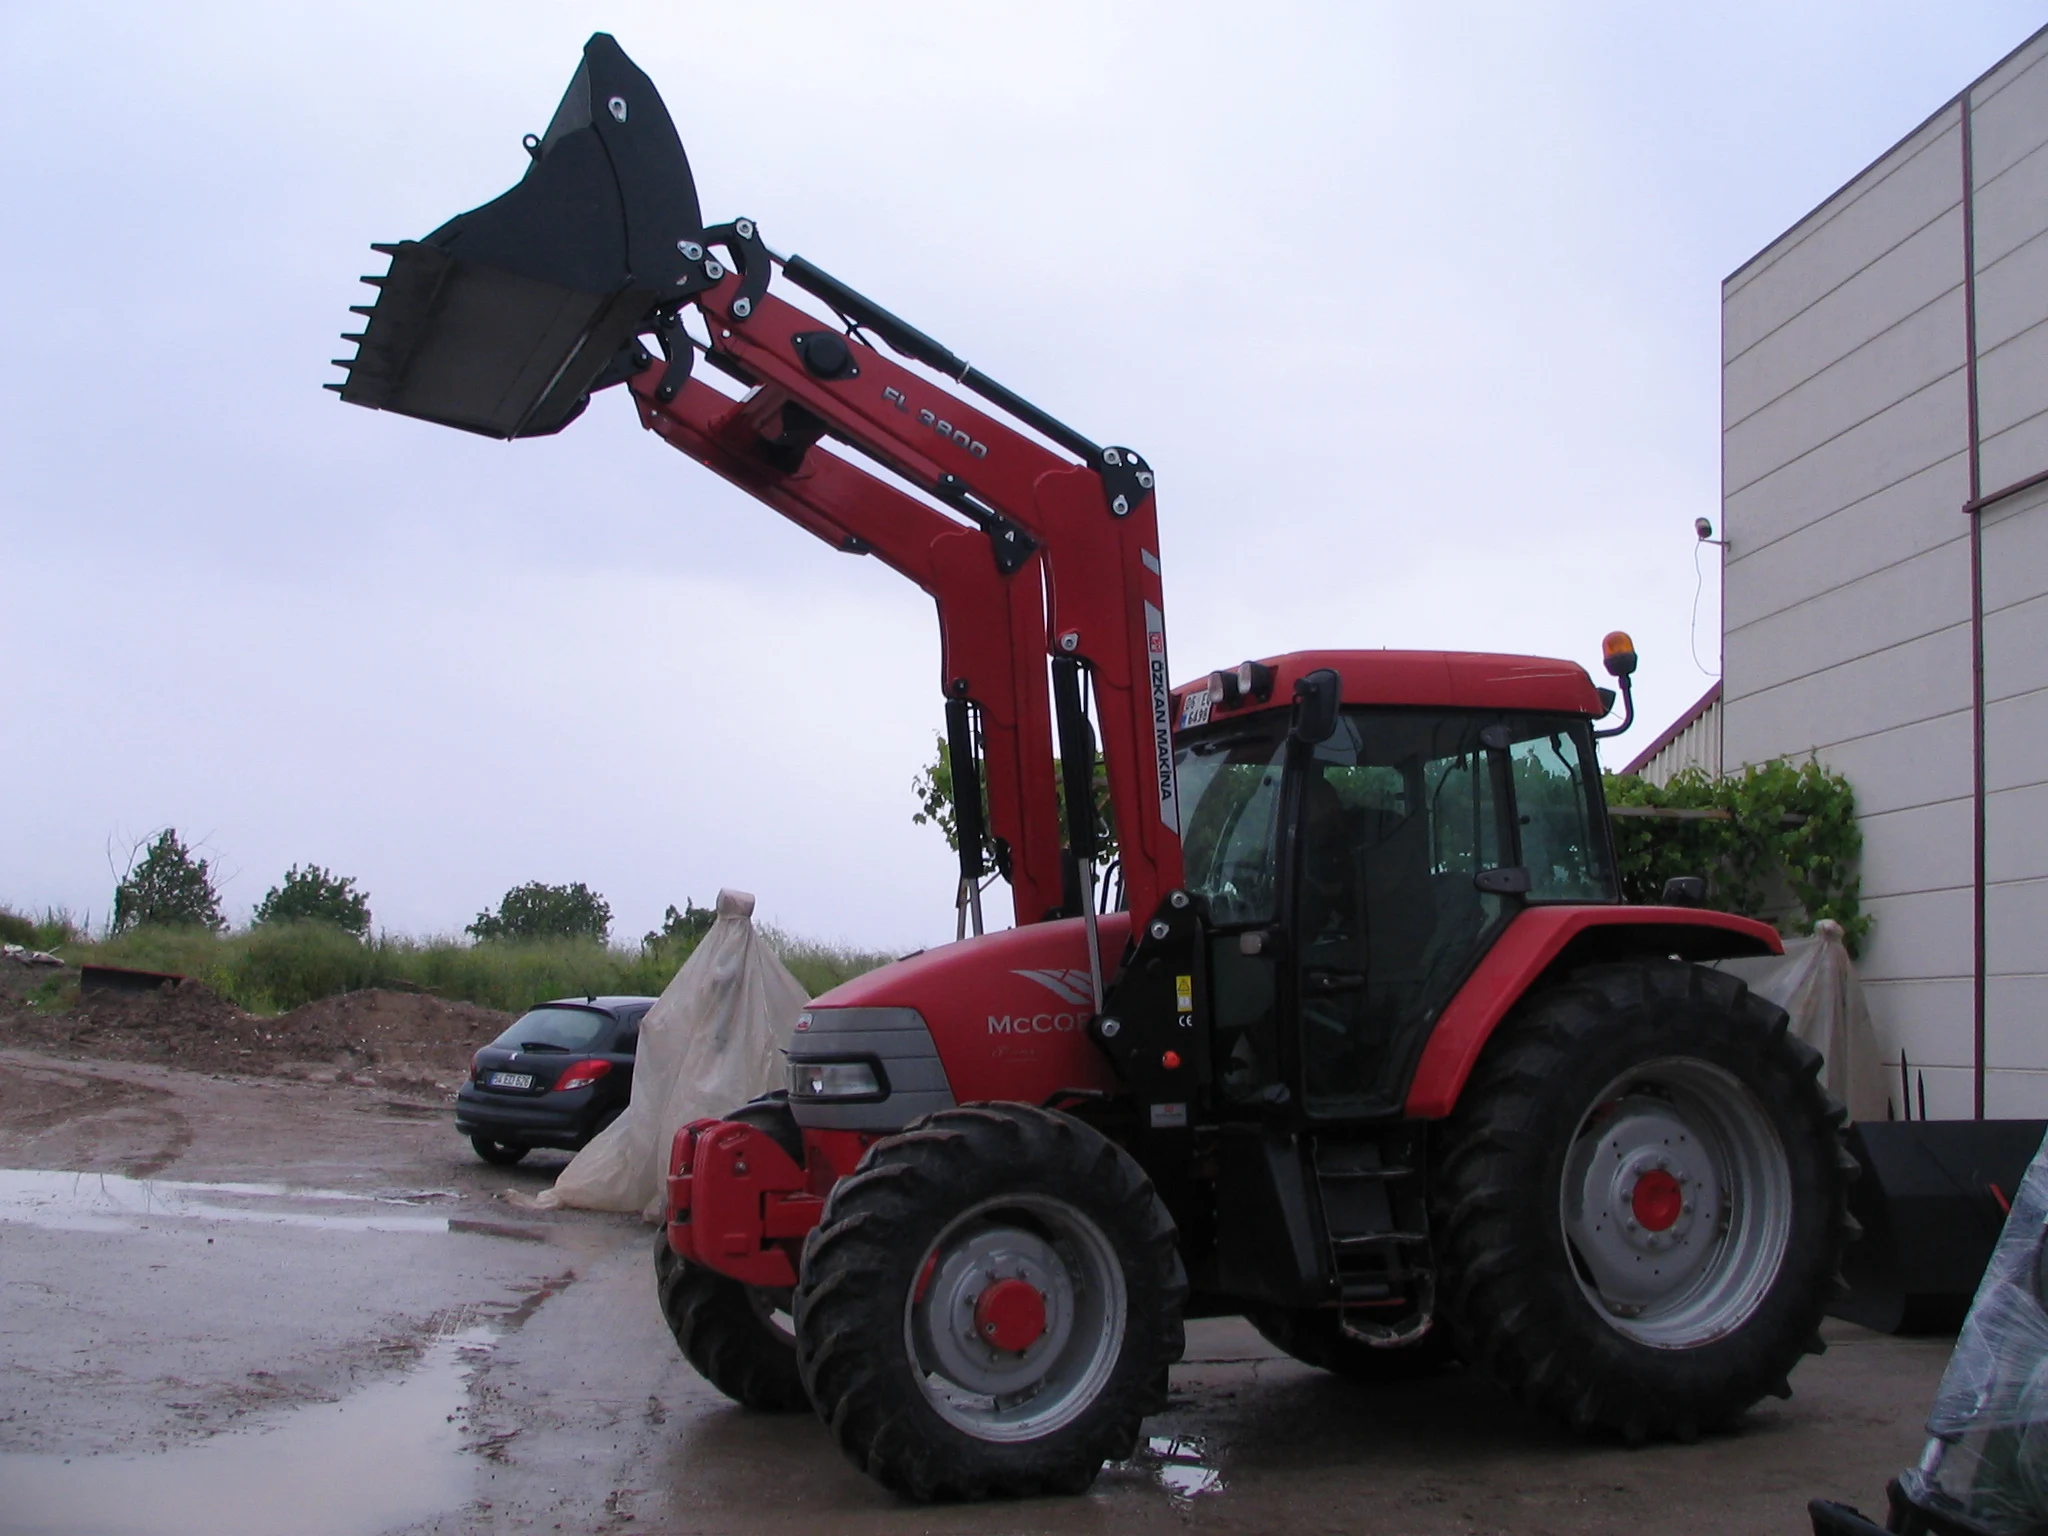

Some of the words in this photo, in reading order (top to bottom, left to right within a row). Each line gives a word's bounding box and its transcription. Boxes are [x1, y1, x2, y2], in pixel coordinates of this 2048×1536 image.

[882, 386, 909, 414] FL
[917, 408, 988, 459] 3800
[1151, 660, 1166, 723] ÖZKAN
[1157, 729, 1172, 801] MAKİNA
